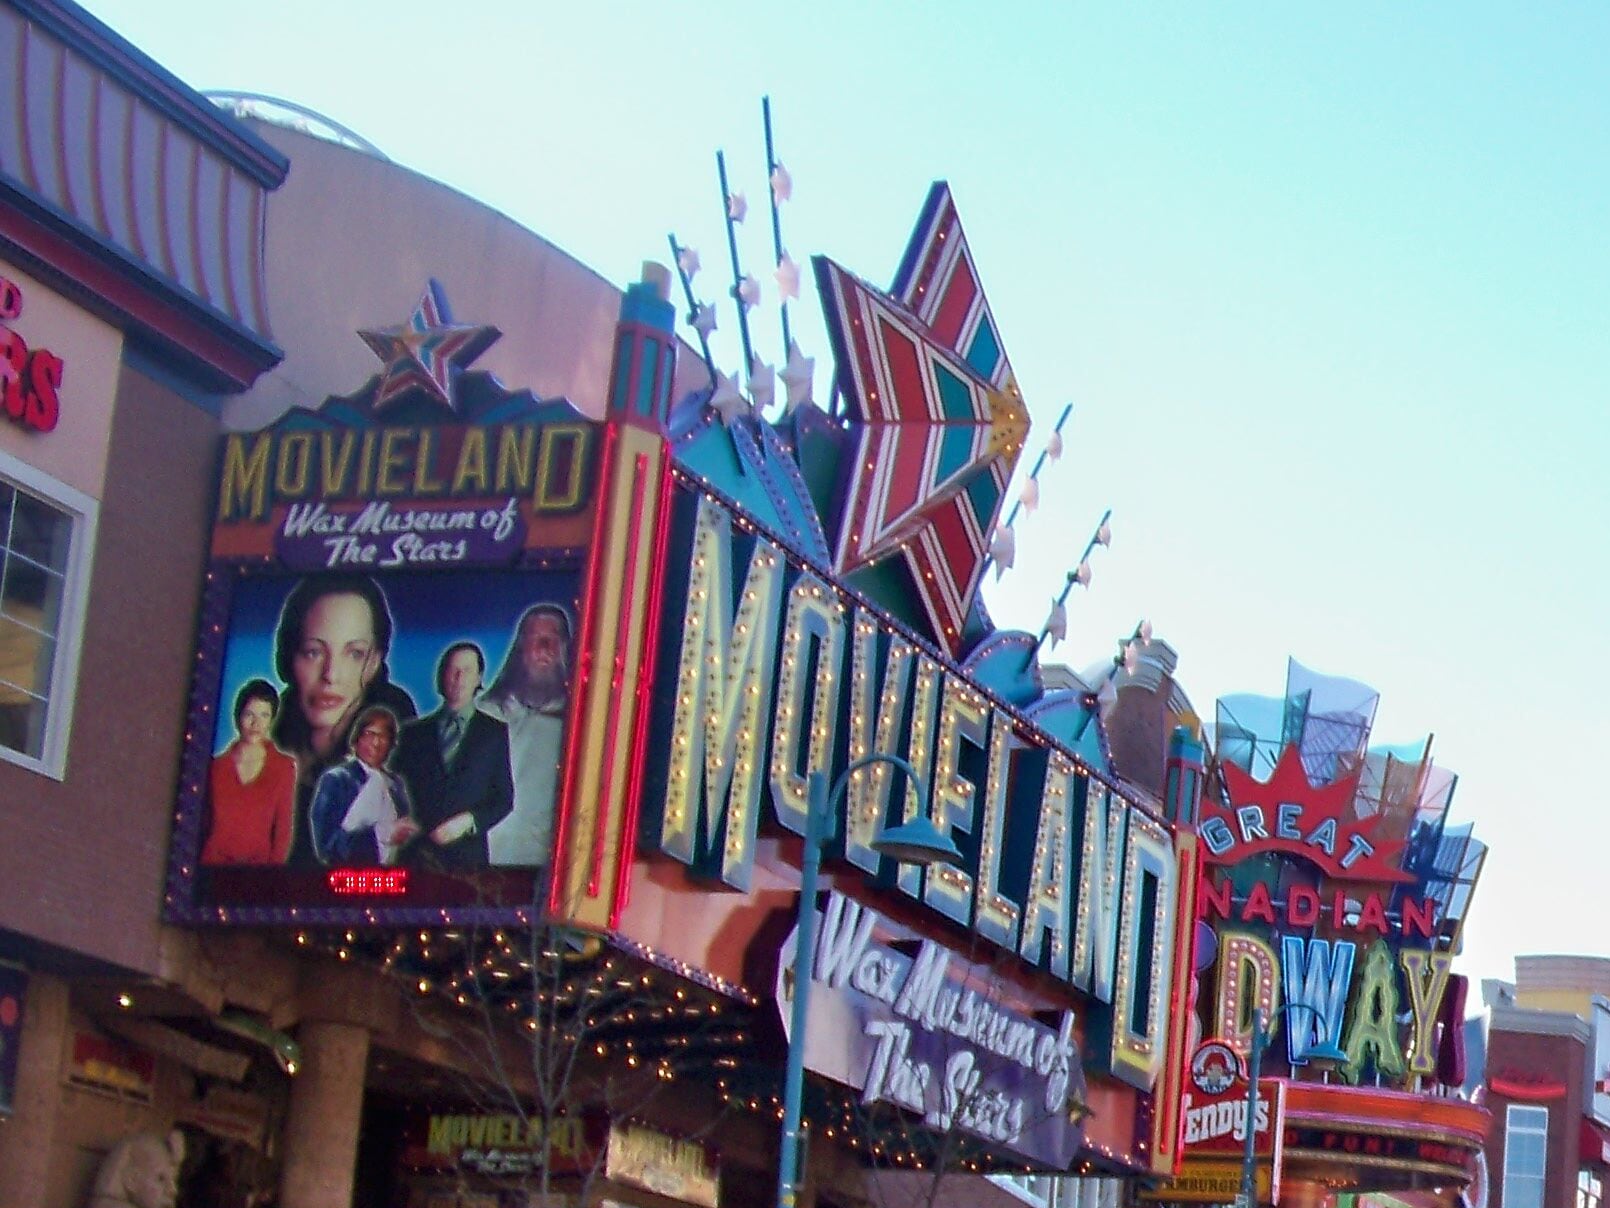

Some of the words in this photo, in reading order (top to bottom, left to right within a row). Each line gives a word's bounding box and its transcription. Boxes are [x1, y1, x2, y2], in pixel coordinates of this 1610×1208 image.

[219, 424, 592, 520] MOVIELAND
[284, 503, 346, 537] Wax
[350, 501, 473, 534] Museum
[481, 498, 517, 541] of
[324, 535, 377, 566] The
[379, 533, 466, 566] Stars
[661, 494, 1177, 1092] MOVIELAND
[1201, 804, 1374, 869] GREAT
[1201, 877, 1435, 938] NADIAN
[812, 889, 899, 1003] Wax
[894, 938, 1035, 1067] Museum
[1035, 1009, 1075, 1113] of
[1216, 931, 1452, 1085] DWAY
[862, 1020, 930, 1115] The
